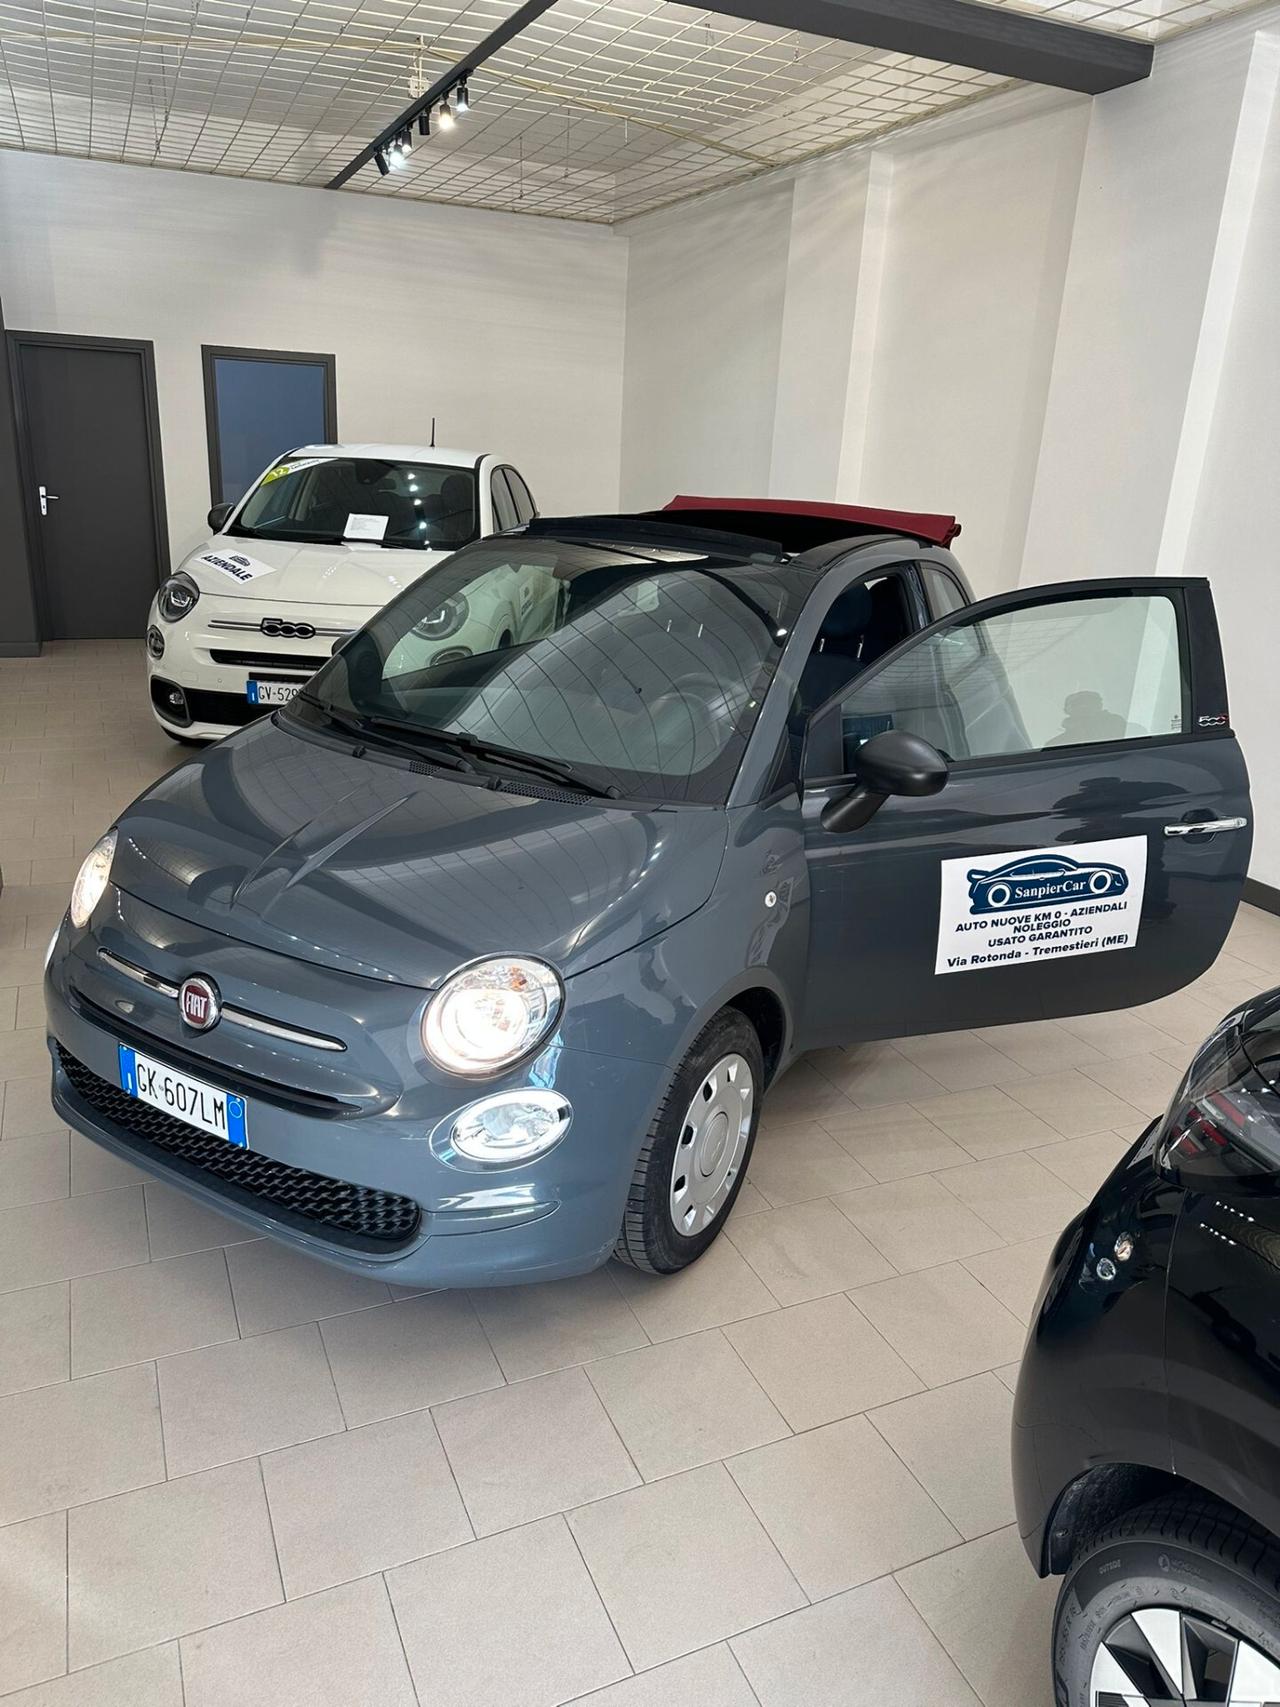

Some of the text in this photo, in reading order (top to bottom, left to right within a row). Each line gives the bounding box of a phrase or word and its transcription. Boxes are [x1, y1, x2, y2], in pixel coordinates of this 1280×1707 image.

[201, 555, 253, 580] AZIENDALE
[261, 617, 316, 639] 500
[1015, 880, 1087, 899] SanpierCar
[955, 920, 988, 932] AUTO
[990, 915, 1032, 928] NUOVE
[1034, 912, 1051, 923] KM
[1071, 901, 1128, 917] AZIENDALI
[1013, 918, 1071, 934] NOLEGGIO
[988, 926, 1093, 948] USATO GARANTITO
[947, 957, 967, 967] Via
[970, 950, 1022, 965] Rotonda
[1032, 937, 1099, 957] Tremestieri
[1102, 934, 1129, 948] (ME)
[185, 991, 208, 1019] FIAT
